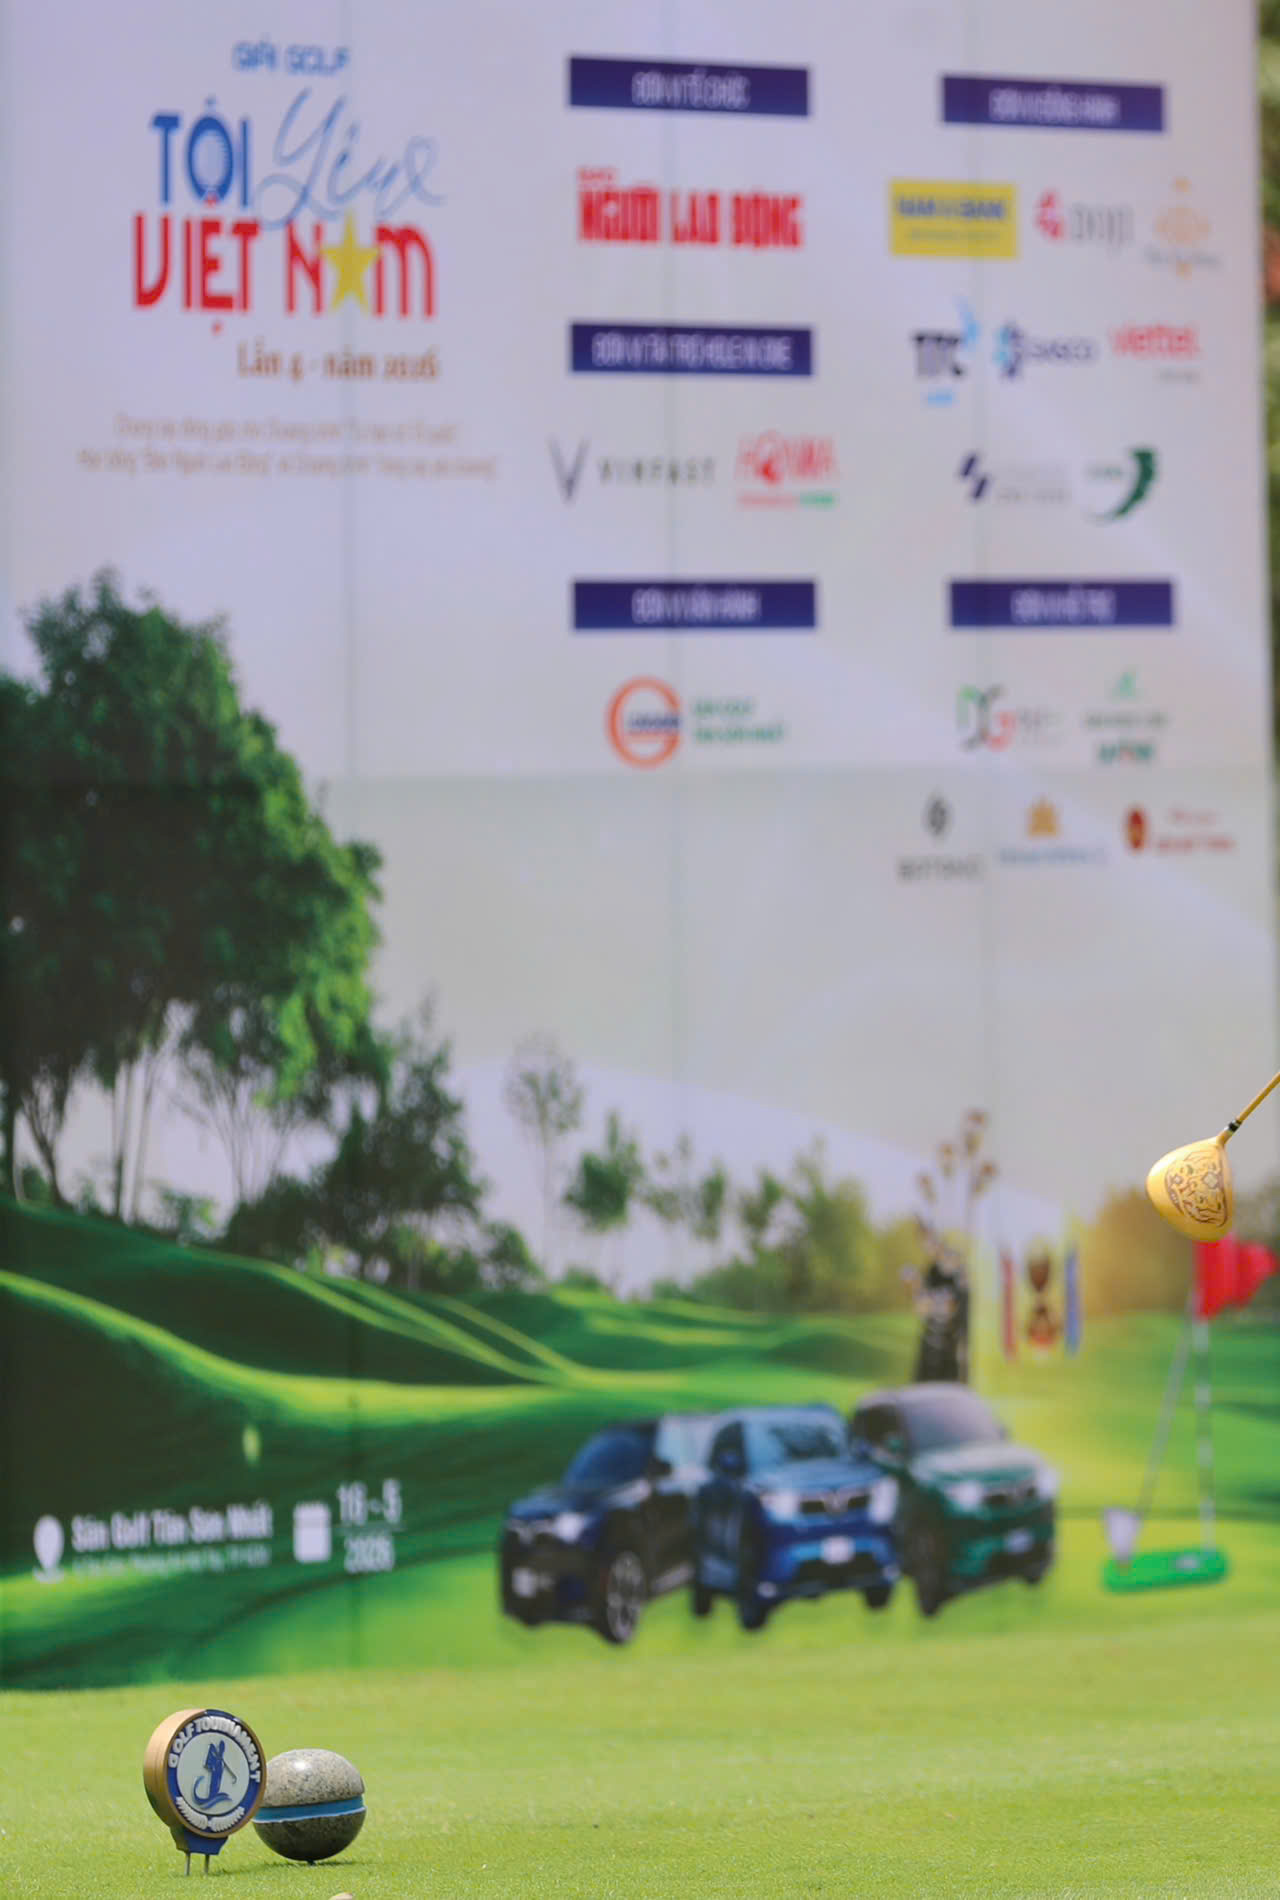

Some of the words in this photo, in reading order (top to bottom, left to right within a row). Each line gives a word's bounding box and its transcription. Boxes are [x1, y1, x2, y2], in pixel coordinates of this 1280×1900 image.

[286, 44, 351, 75] GOLF
[598, 456, 716, 484] VINFAST
[111, 1511, 149, 1549] Golf
[168, 1721, 195, 1769] GOLF
[193, 1715, 261, 1783] TOURNAMENT
